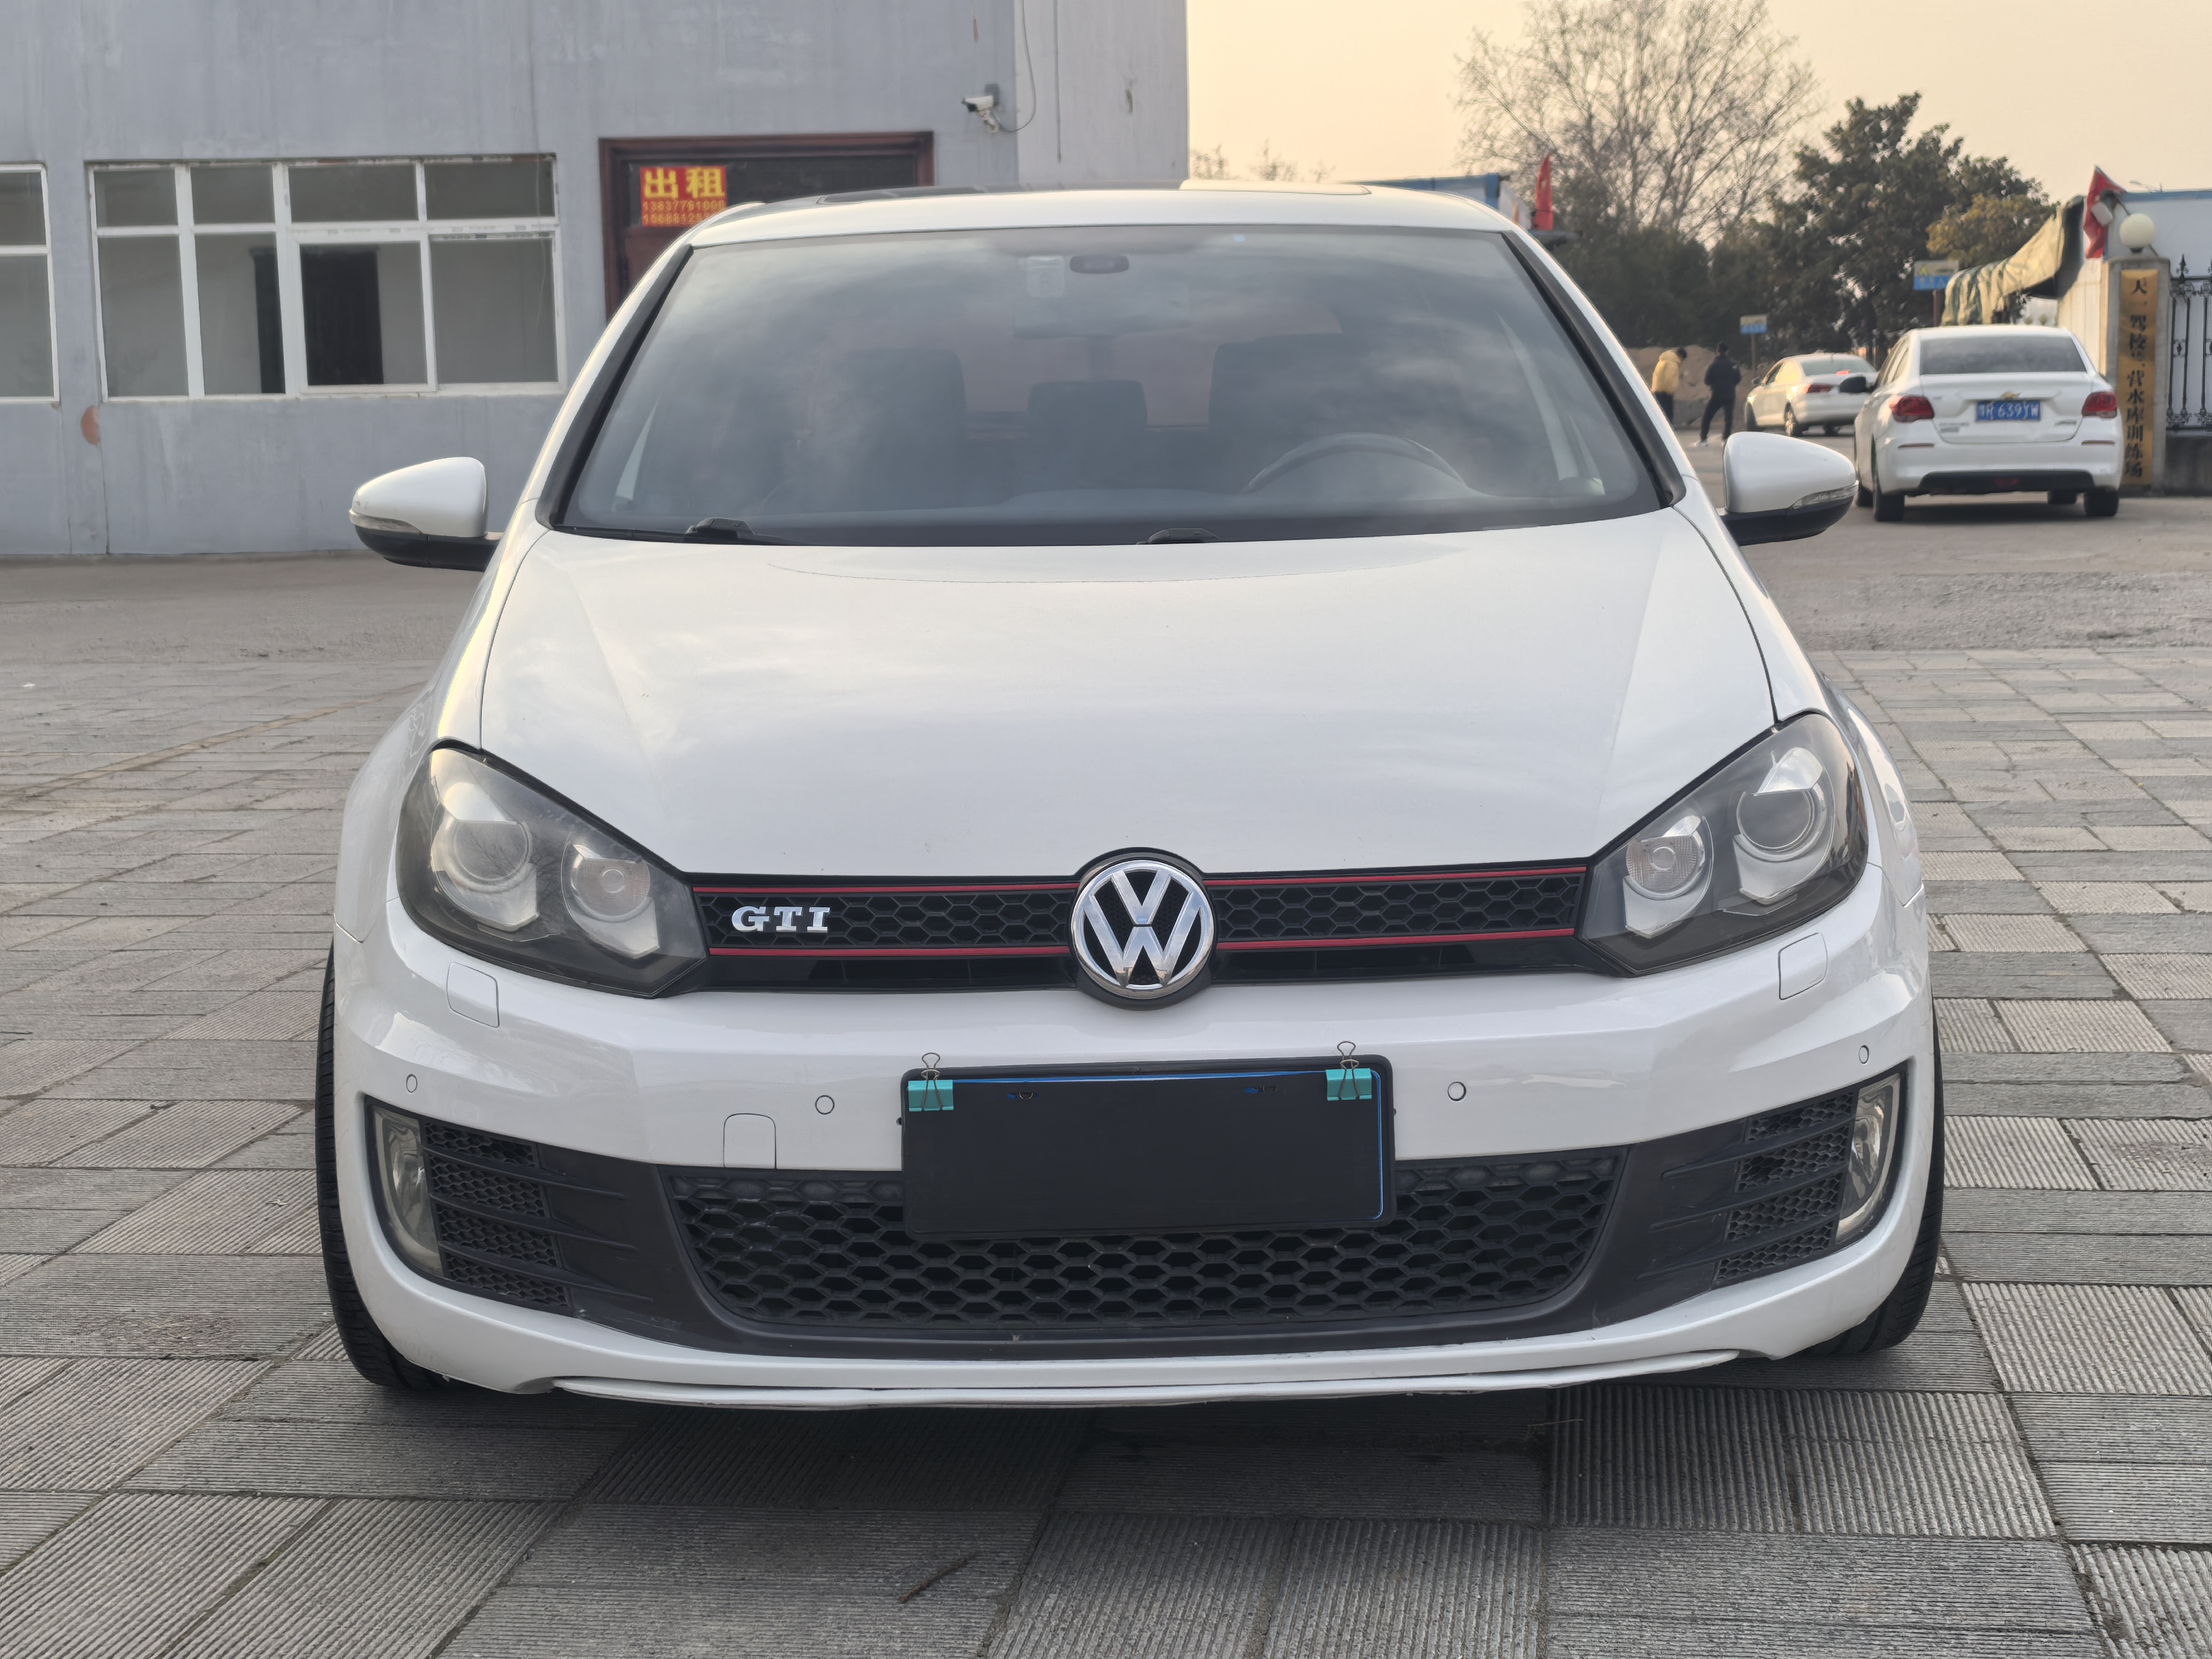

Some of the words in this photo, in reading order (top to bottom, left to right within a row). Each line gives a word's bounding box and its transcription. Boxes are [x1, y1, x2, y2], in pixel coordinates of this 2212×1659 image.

[645, 167, 725, 199] 出租
[731, 905, 831, 933] GTI
[1078, 866, 1208, 989] VW
